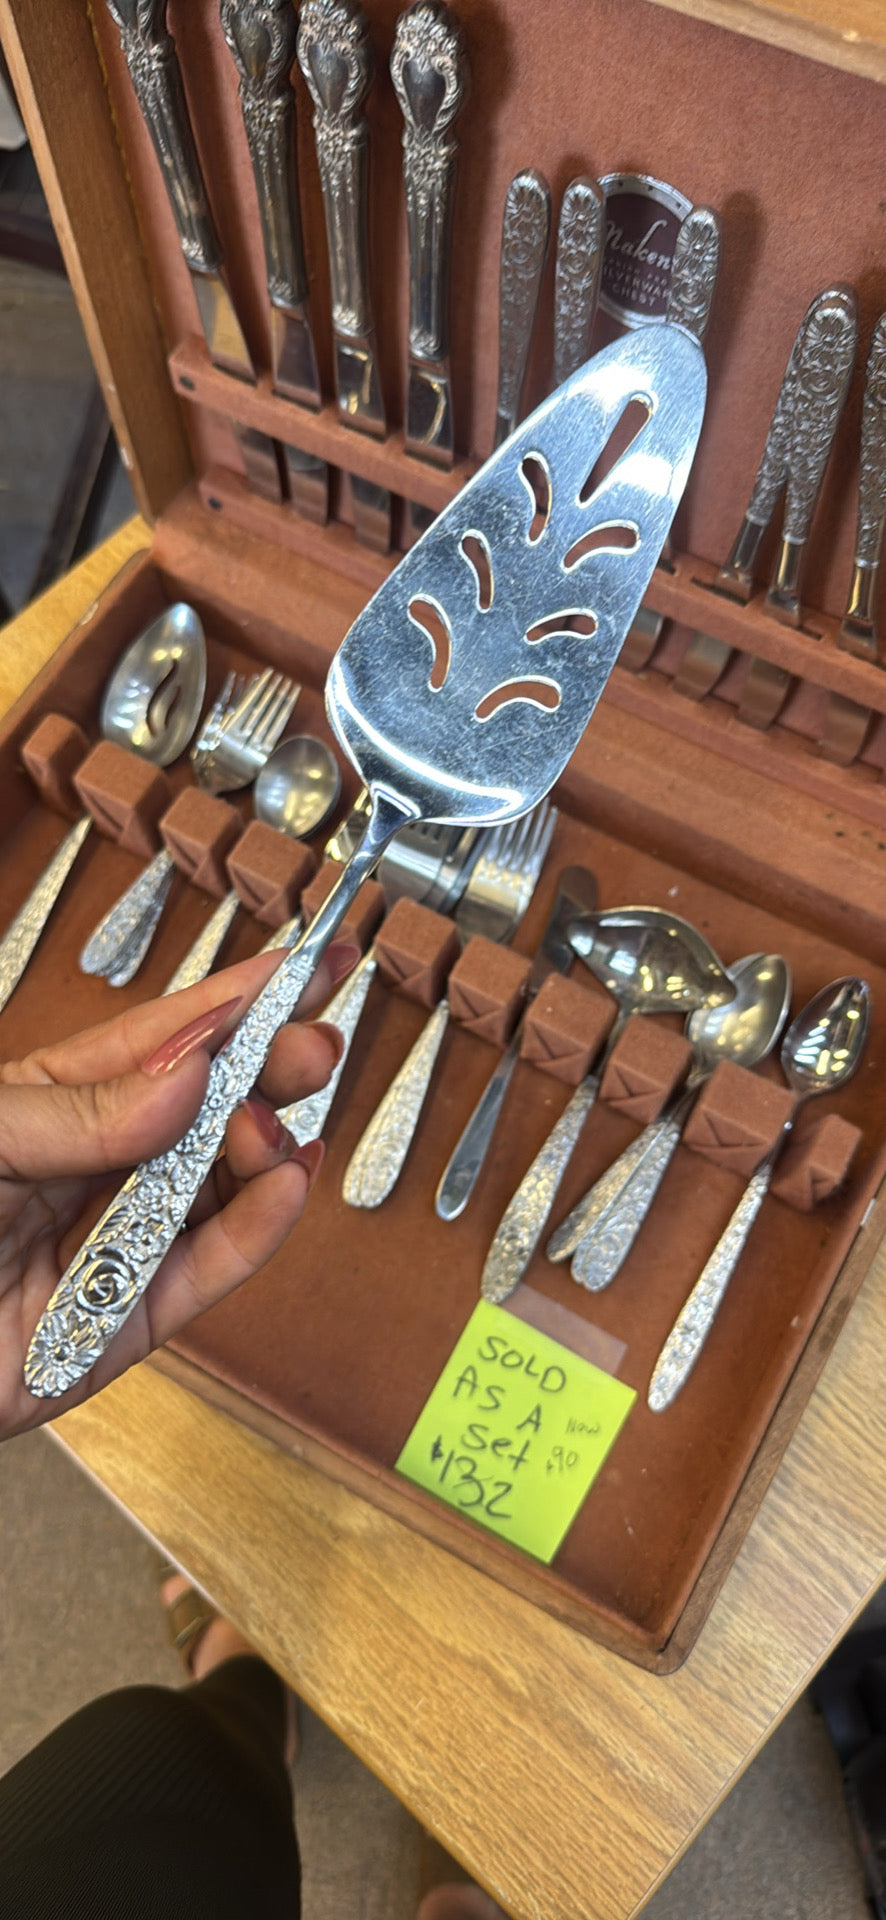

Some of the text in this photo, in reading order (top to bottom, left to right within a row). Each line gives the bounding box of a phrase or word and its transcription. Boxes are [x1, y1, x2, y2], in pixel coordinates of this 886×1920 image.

[604, 219, 672, 270] Naken
[602, 264, 673, 299] ILVERWAR
[612, 282, 657, 307] CHEST
[477, 1335, 567, 1394] SOLD
[452, 1364, 543, 1433] AS A
[460, 1423, 530, 1471] Set
[431, 1434, 513, 1520] $132
